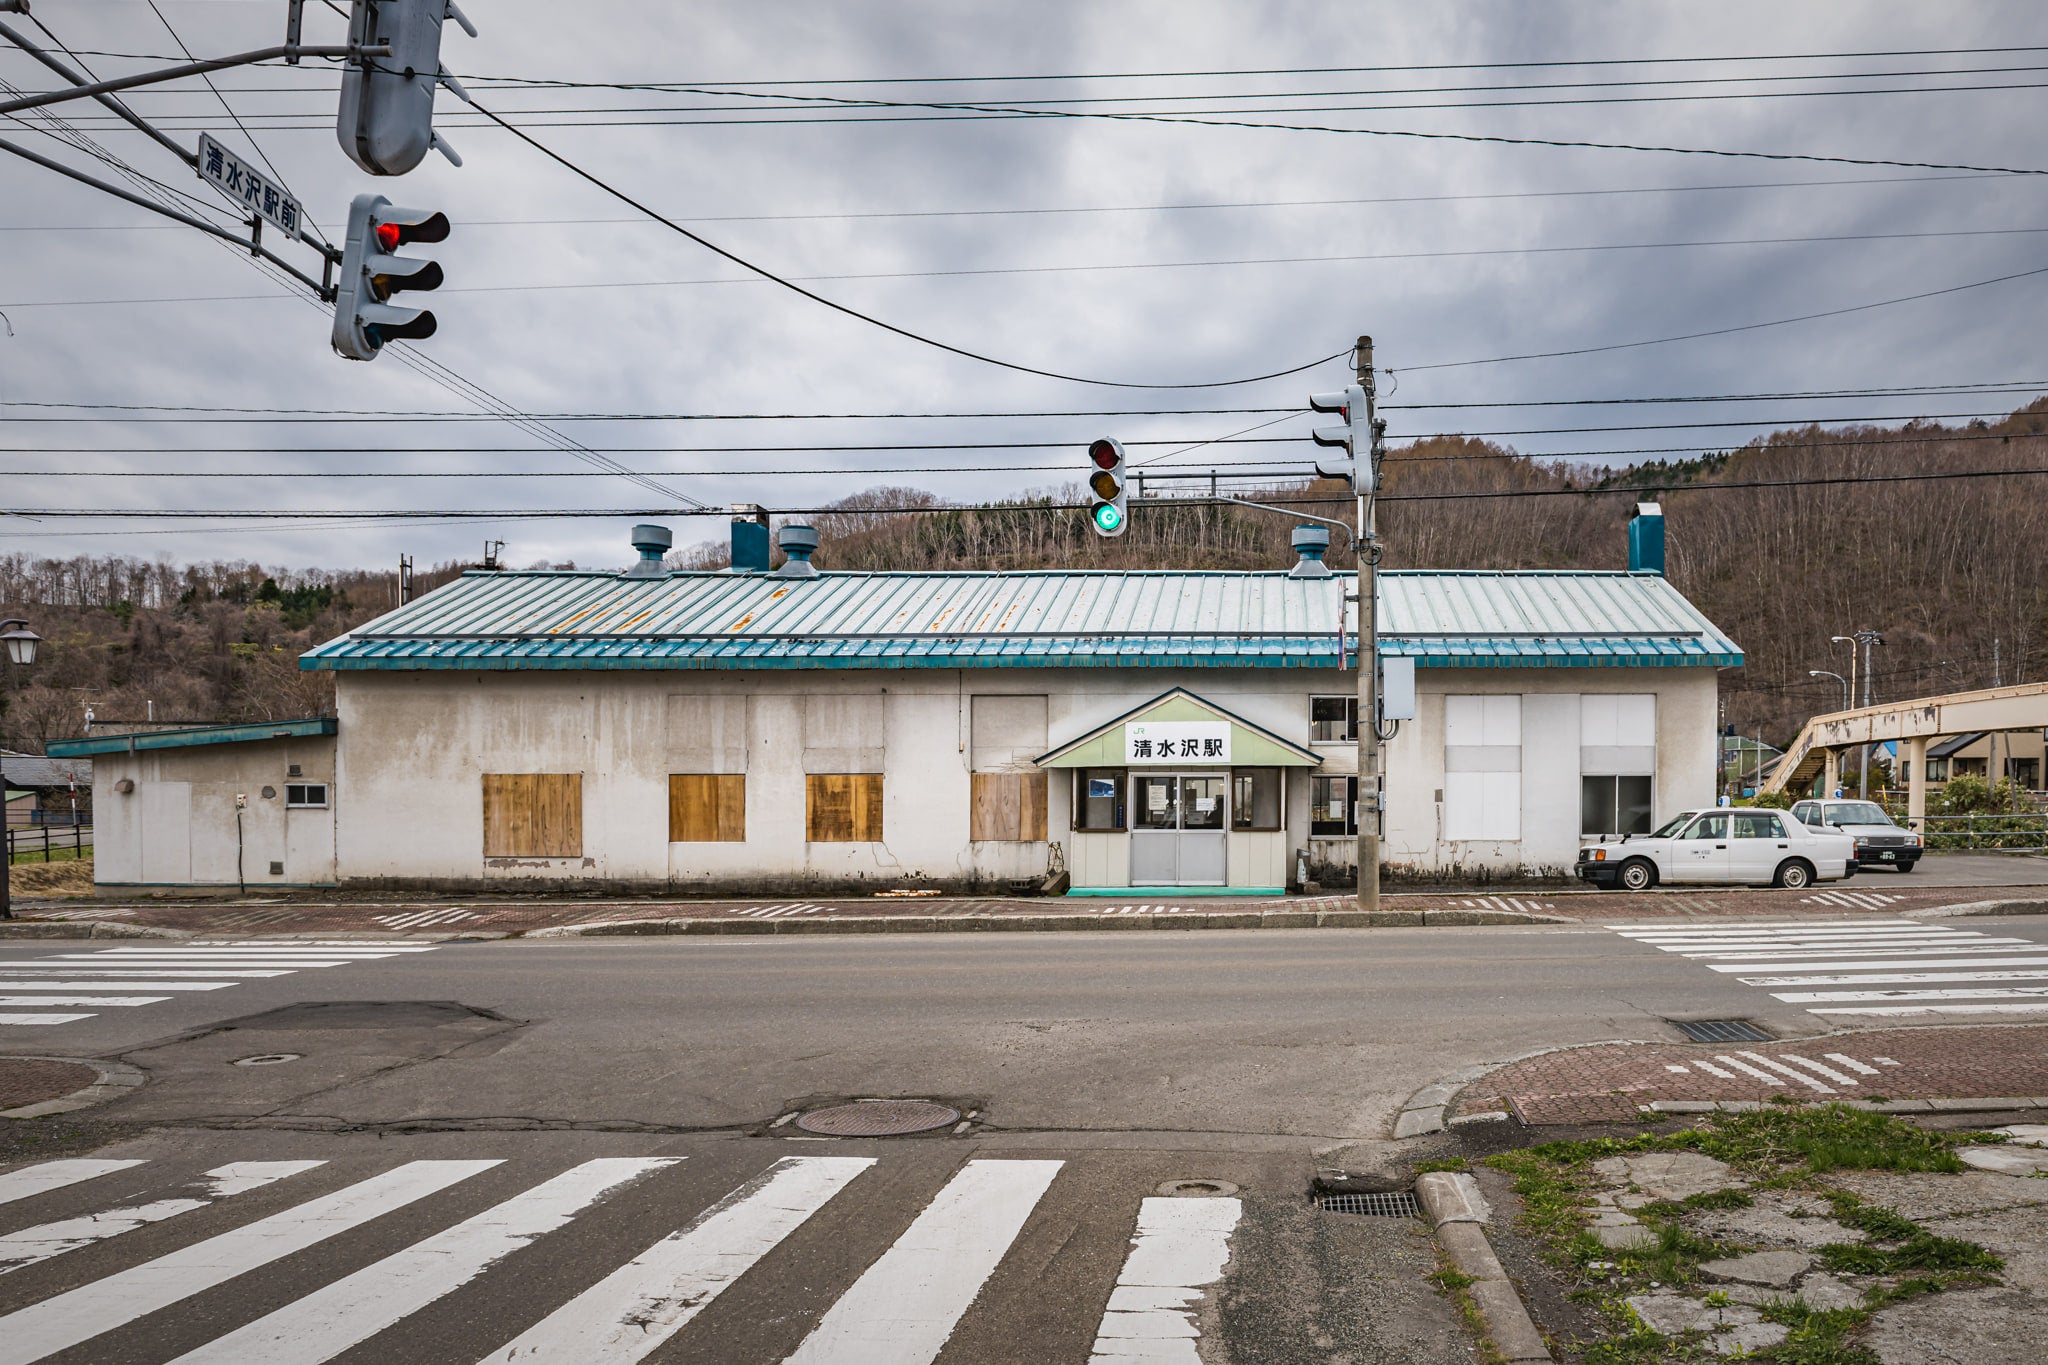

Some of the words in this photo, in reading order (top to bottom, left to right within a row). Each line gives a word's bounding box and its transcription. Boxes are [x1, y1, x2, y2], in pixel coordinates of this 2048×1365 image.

[206, 142, 297, 232] 清水沢駅前
[1133, 727, 1145, 735] JR
[1133, 738, 1223, 758] 清水沢駅
